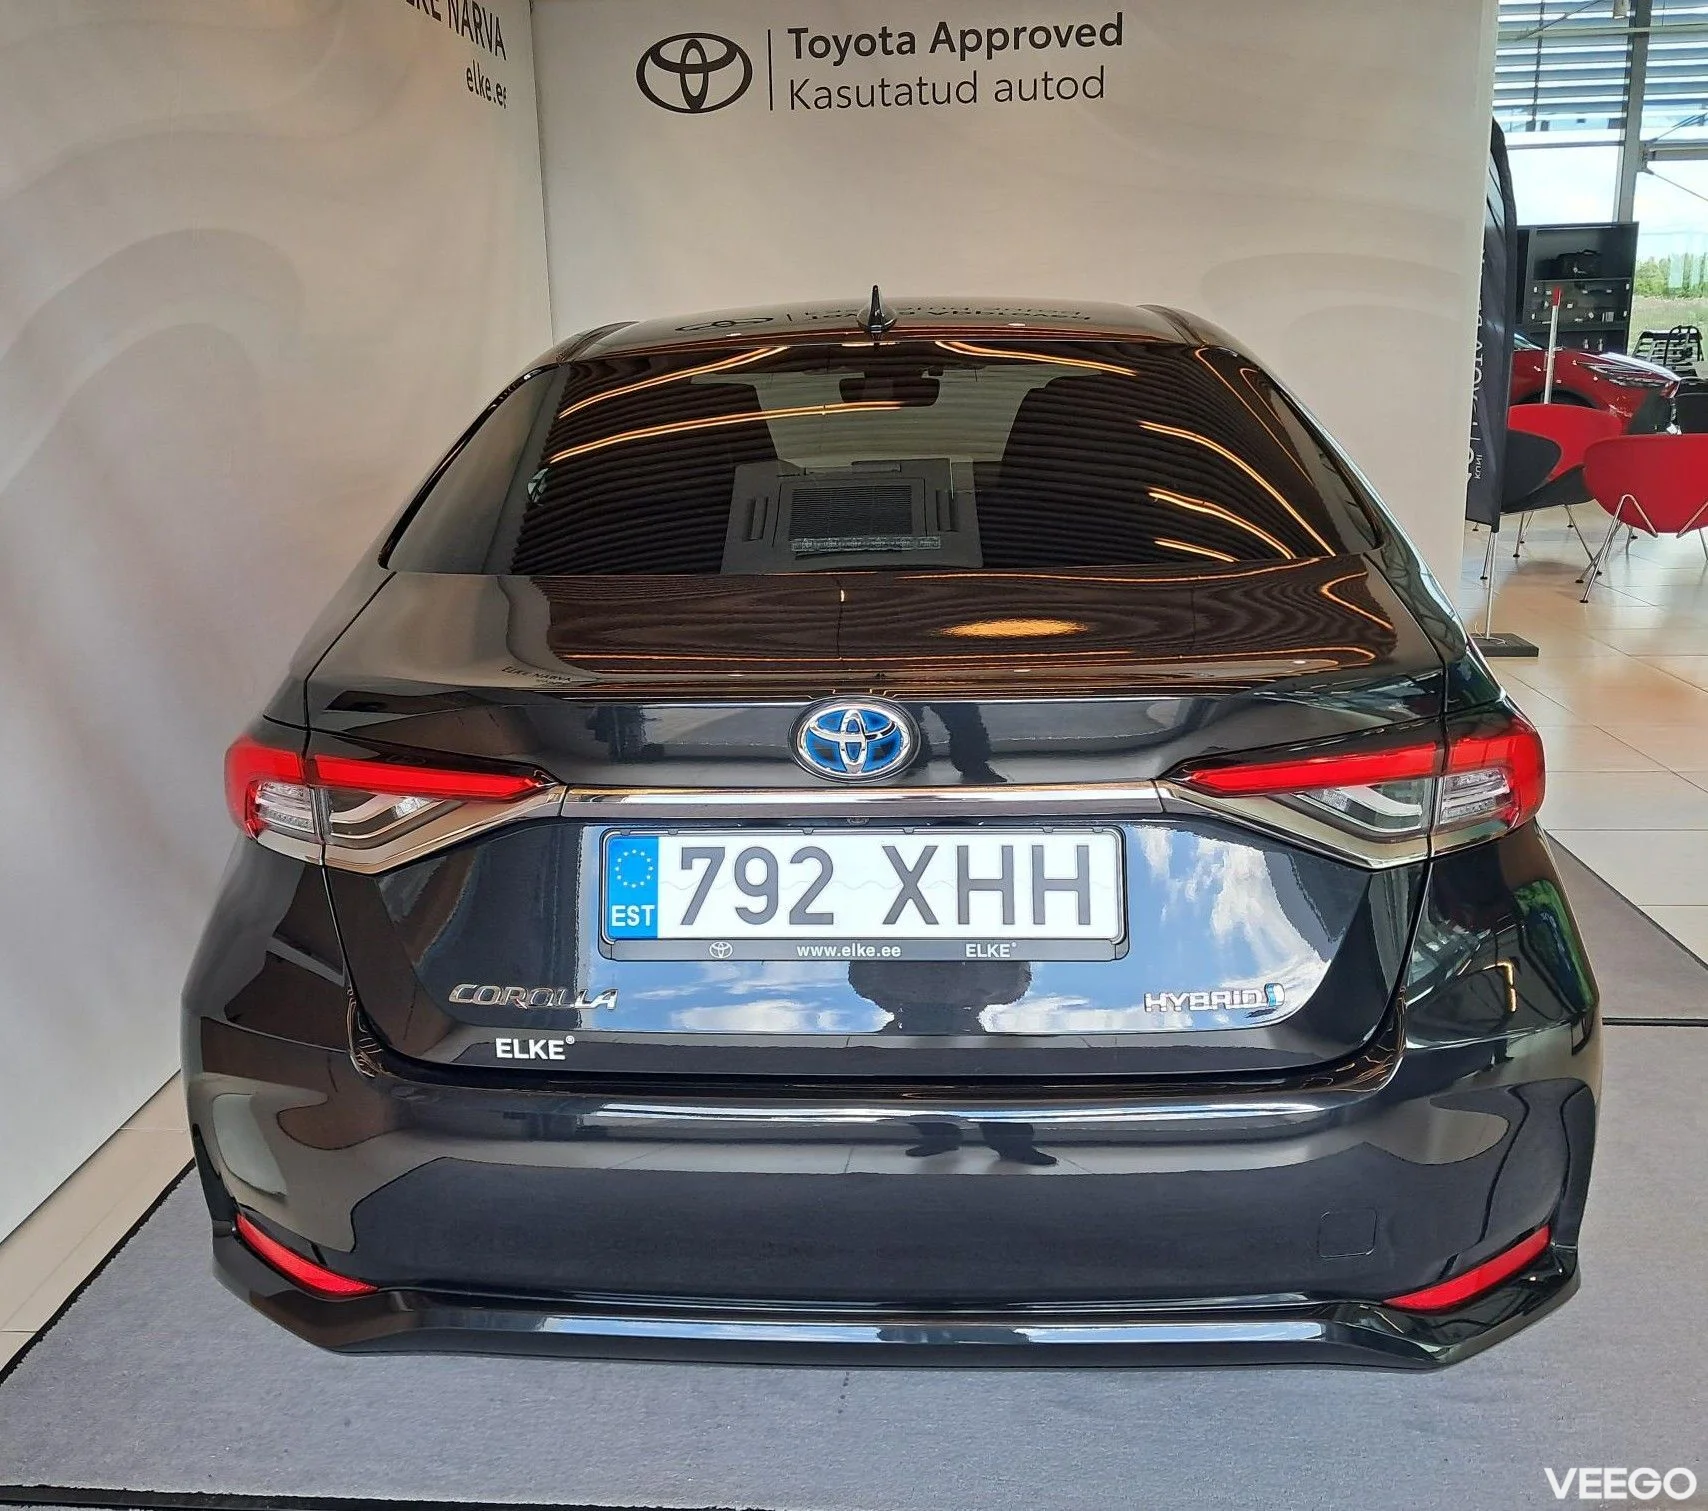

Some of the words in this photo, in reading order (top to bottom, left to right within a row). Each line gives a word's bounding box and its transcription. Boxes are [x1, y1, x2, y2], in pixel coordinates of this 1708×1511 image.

[447, 0, 507, 61] NARVA
[787, 26, 916, 66] Toyota
[929, 12, 1124, 62] Approved
[789, 70, 978, 111] Kasutatud
[994, 65, 1105, 102] autod
[680, 845, 835, 926] 792
[881, 844, 1091, 926] XHH
[611, 905, 655, 927] EST
[797, 943, 902, 958] www.elke.ee
[449, 983, 619, 1011] COROLLA
[1144, 988, 1268, 1012] HYBRID
